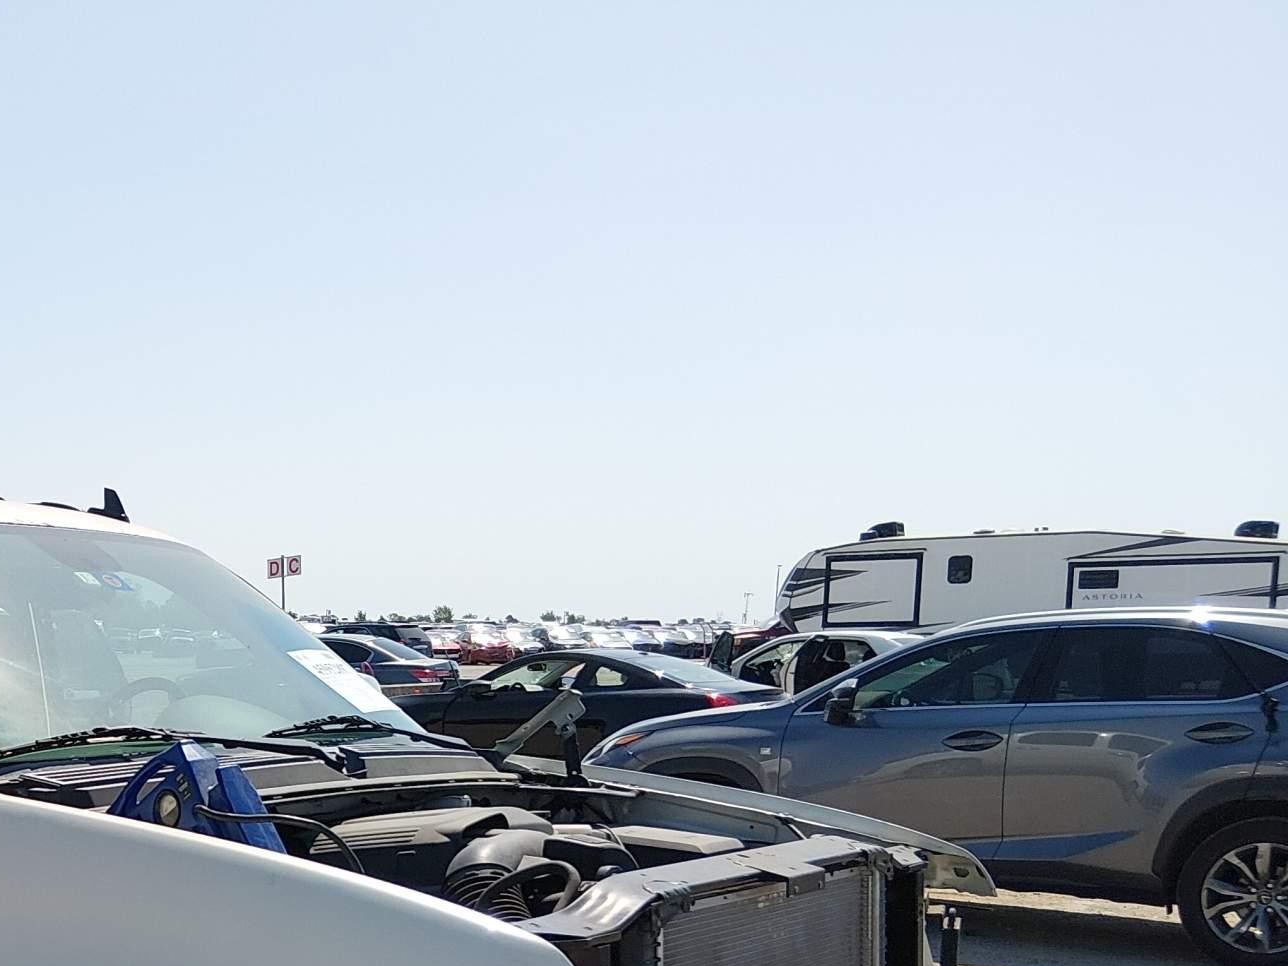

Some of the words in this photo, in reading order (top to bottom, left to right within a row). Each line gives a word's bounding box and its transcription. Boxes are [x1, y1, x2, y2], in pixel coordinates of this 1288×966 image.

[269, 561, 279, 576] D
[289, 558, 299, 573] C
[1082, 592, 1143, 601] ASTORIA
